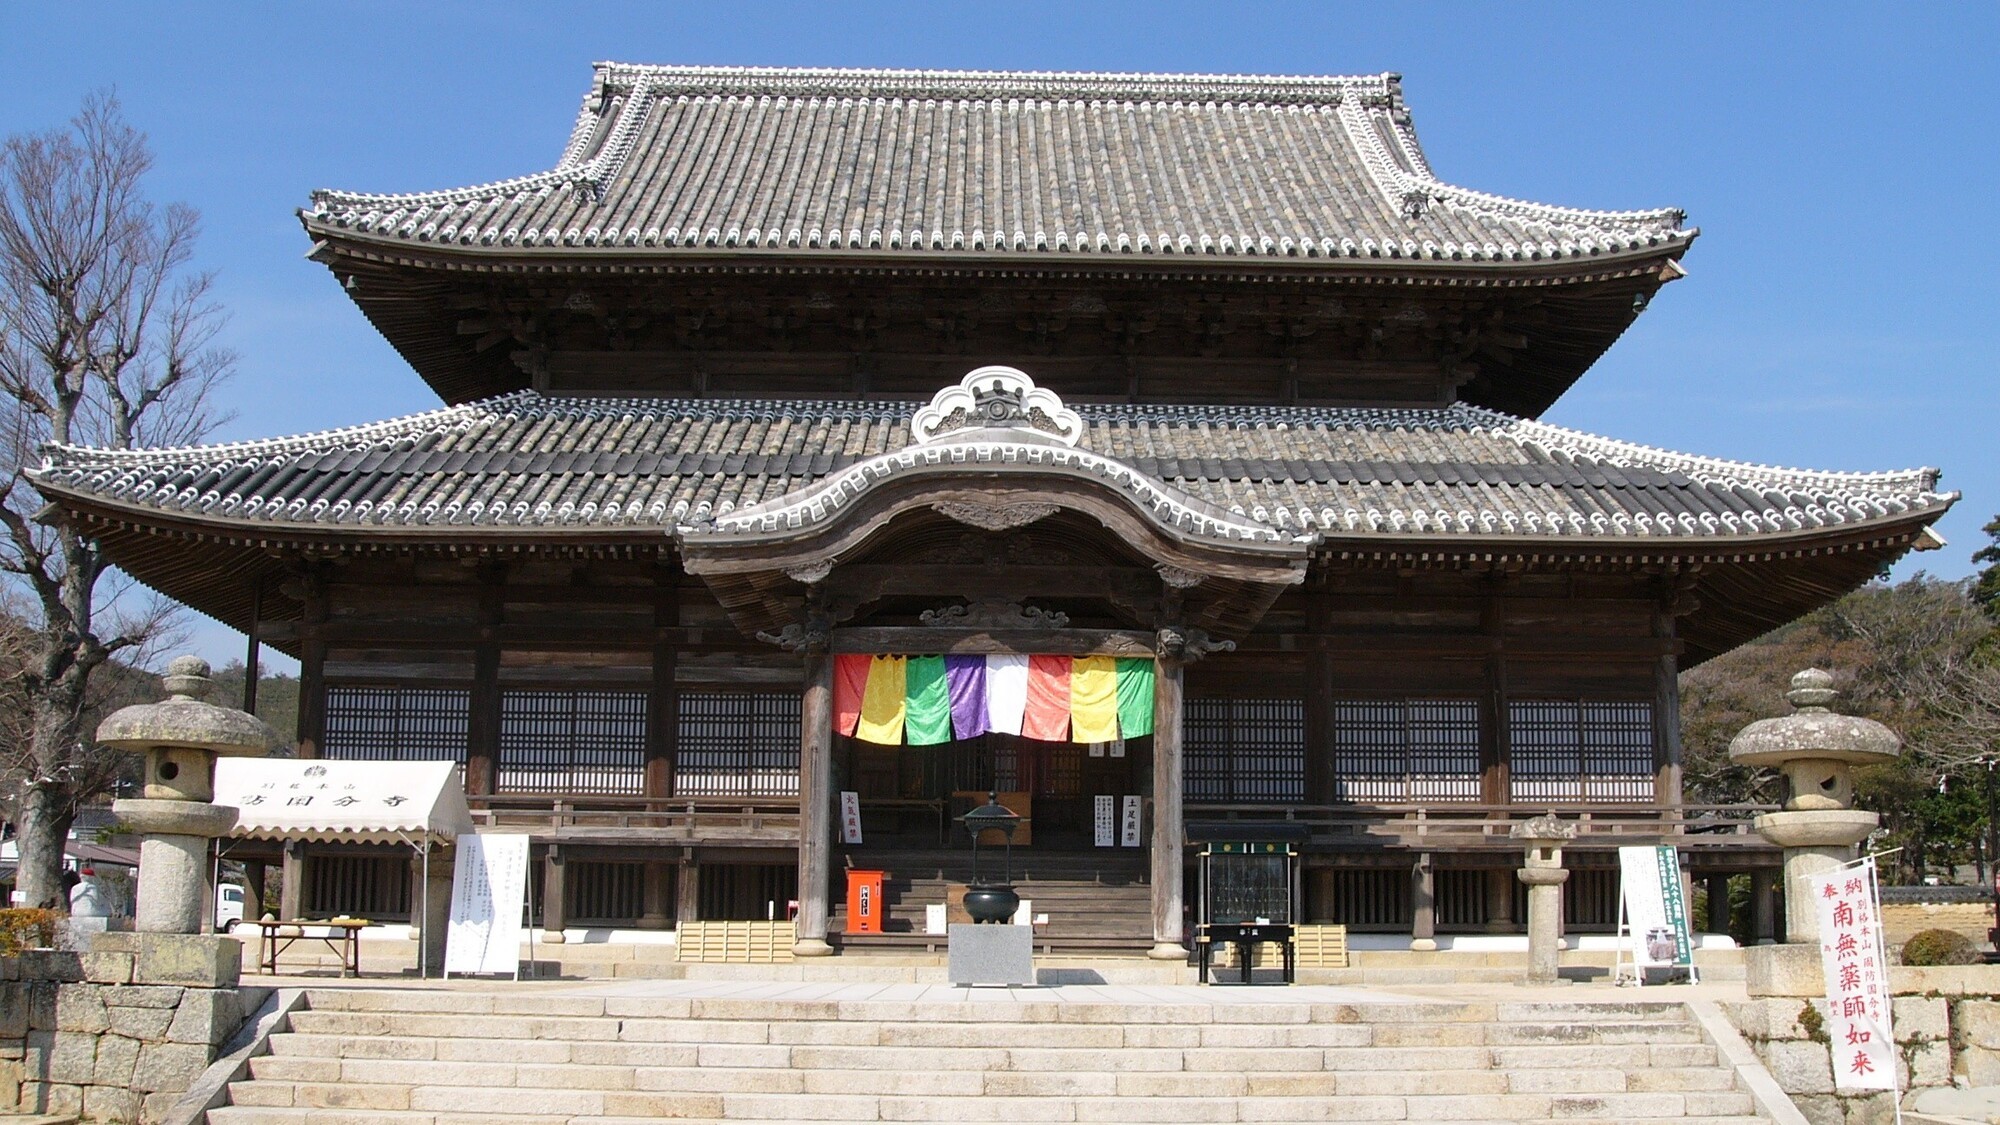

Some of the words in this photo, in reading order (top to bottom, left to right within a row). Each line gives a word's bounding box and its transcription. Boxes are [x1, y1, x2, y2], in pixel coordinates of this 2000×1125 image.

[1126, 798, 1137, 842] 土足厳禁
[1822, 877, 1863, 899] 奉納
[1857, 898, 1872, 950] 別格本山
[1833, 900, 1875, 1076] 南無薬師如来
[1863, 956, 1880, 1022] 周防国分寺
